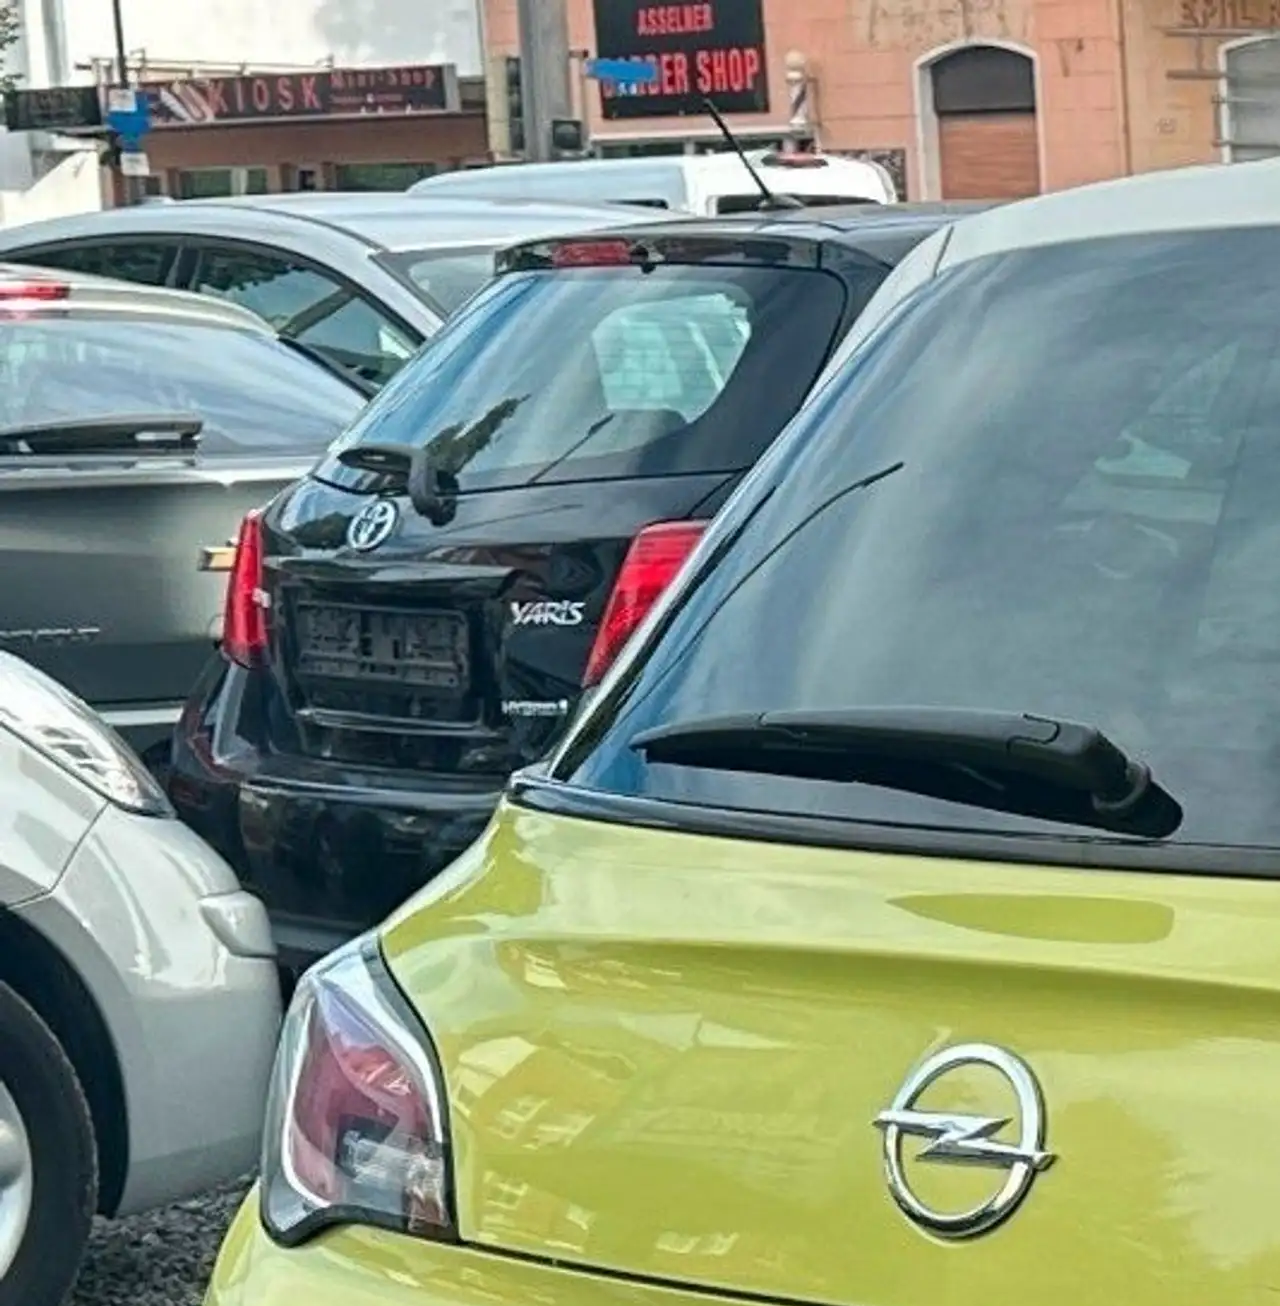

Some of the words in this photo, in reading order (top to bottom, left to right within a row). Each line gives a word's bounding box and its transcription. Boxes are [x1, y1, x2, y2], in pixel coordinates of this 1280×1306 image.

[696, 48, 760, 94] SHOP
[206, 75, 322, 115] KIOSK
[509, 600, 587, 626] YARIS
